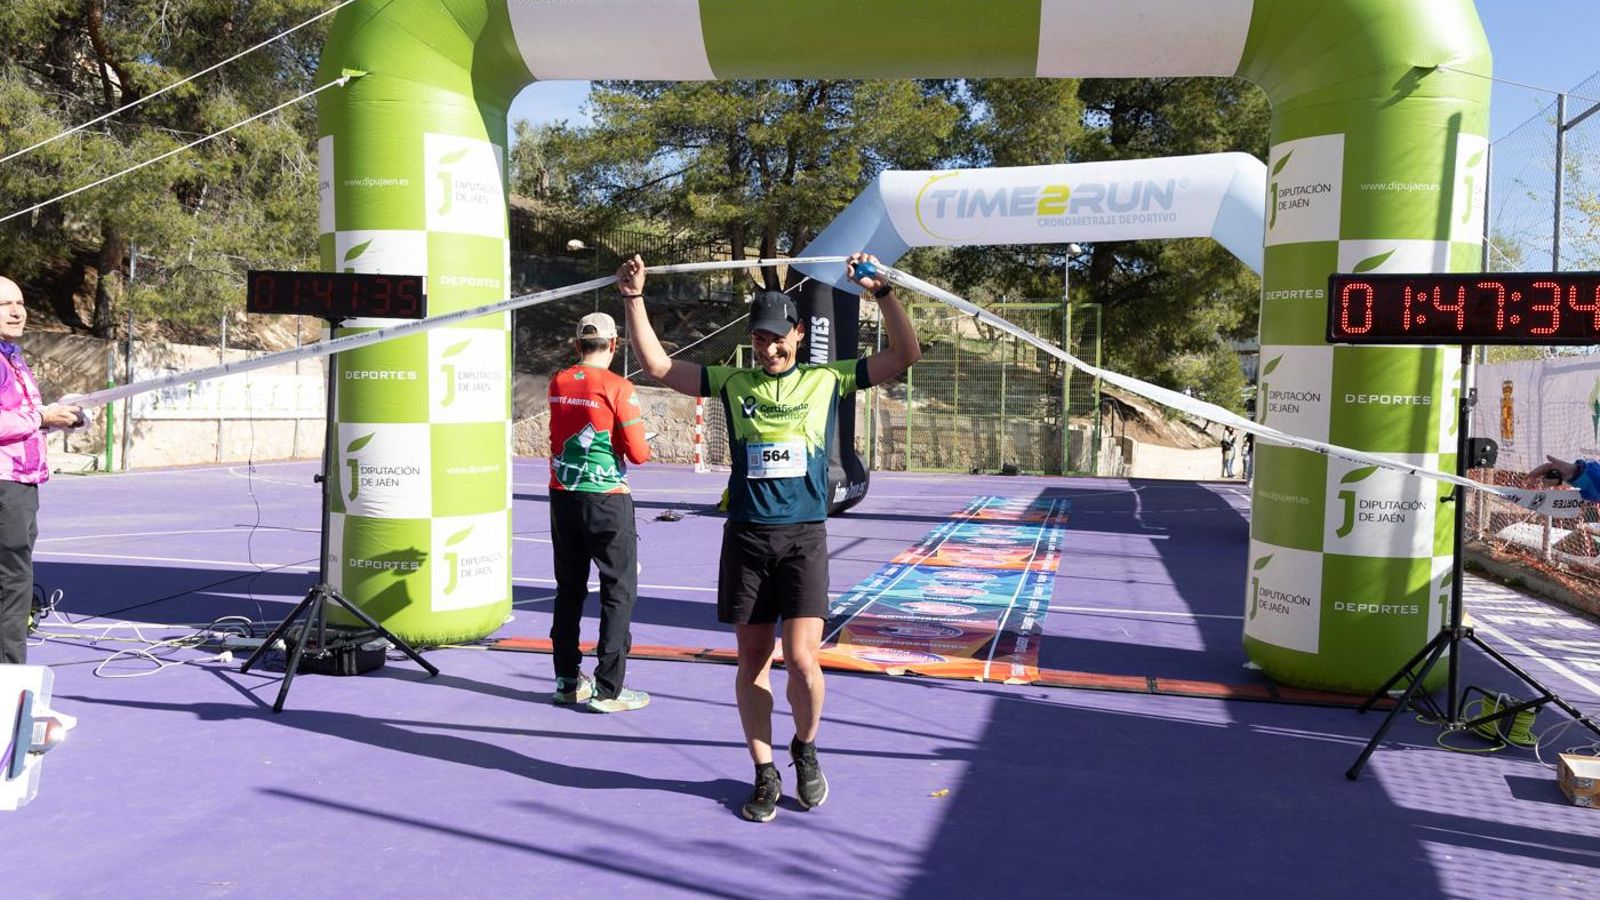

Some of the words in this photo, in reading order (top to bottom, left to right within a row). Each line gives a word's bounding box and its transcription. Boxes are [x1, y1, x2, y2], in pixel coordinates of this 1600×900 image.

[1278, 183, 1331, 198] DIPUTACIÓN
[930, 178, 1175, 219] TIME2RUN
[1278, 201, 1288, 210] DE
[1038, 215, 1118, 228] CRONOMETRAJE
[1118, 212, 1177, 225] DEPORTIVO
[440, 275, 500, 288] DEPORTES
[1265, 289, 1325, 300] DEPORTES
[810, 316, 830, 366] MITES
[345, 370, 417, 380] DEPORTES
[1269, 390, 1321, 402] DIPUTACIÓN
[1344, 393, 1432, 405] DEPORTES
[760, 402, 809, 414] Certificado
[1268, 403, 1279, 413] DE
[762, 450, 790, 463] 564
[360, 465, 420, 476] DIPUTACIÓN
[360, 477, 373, 487] DE
[1359, 499, 1426, 511] DIPUTACIÓN
[1358, 512, 1375, 522] DE
[1376, 512, 1406, 524] JAÉN
[349, 558, 420, 570] DEPORTES
[1259, 587, 1311, 607] DIPUTACIÓN
[1258, 598, 1269, 610] DE
[1334, 601, 1419, 614] DEPORTES
